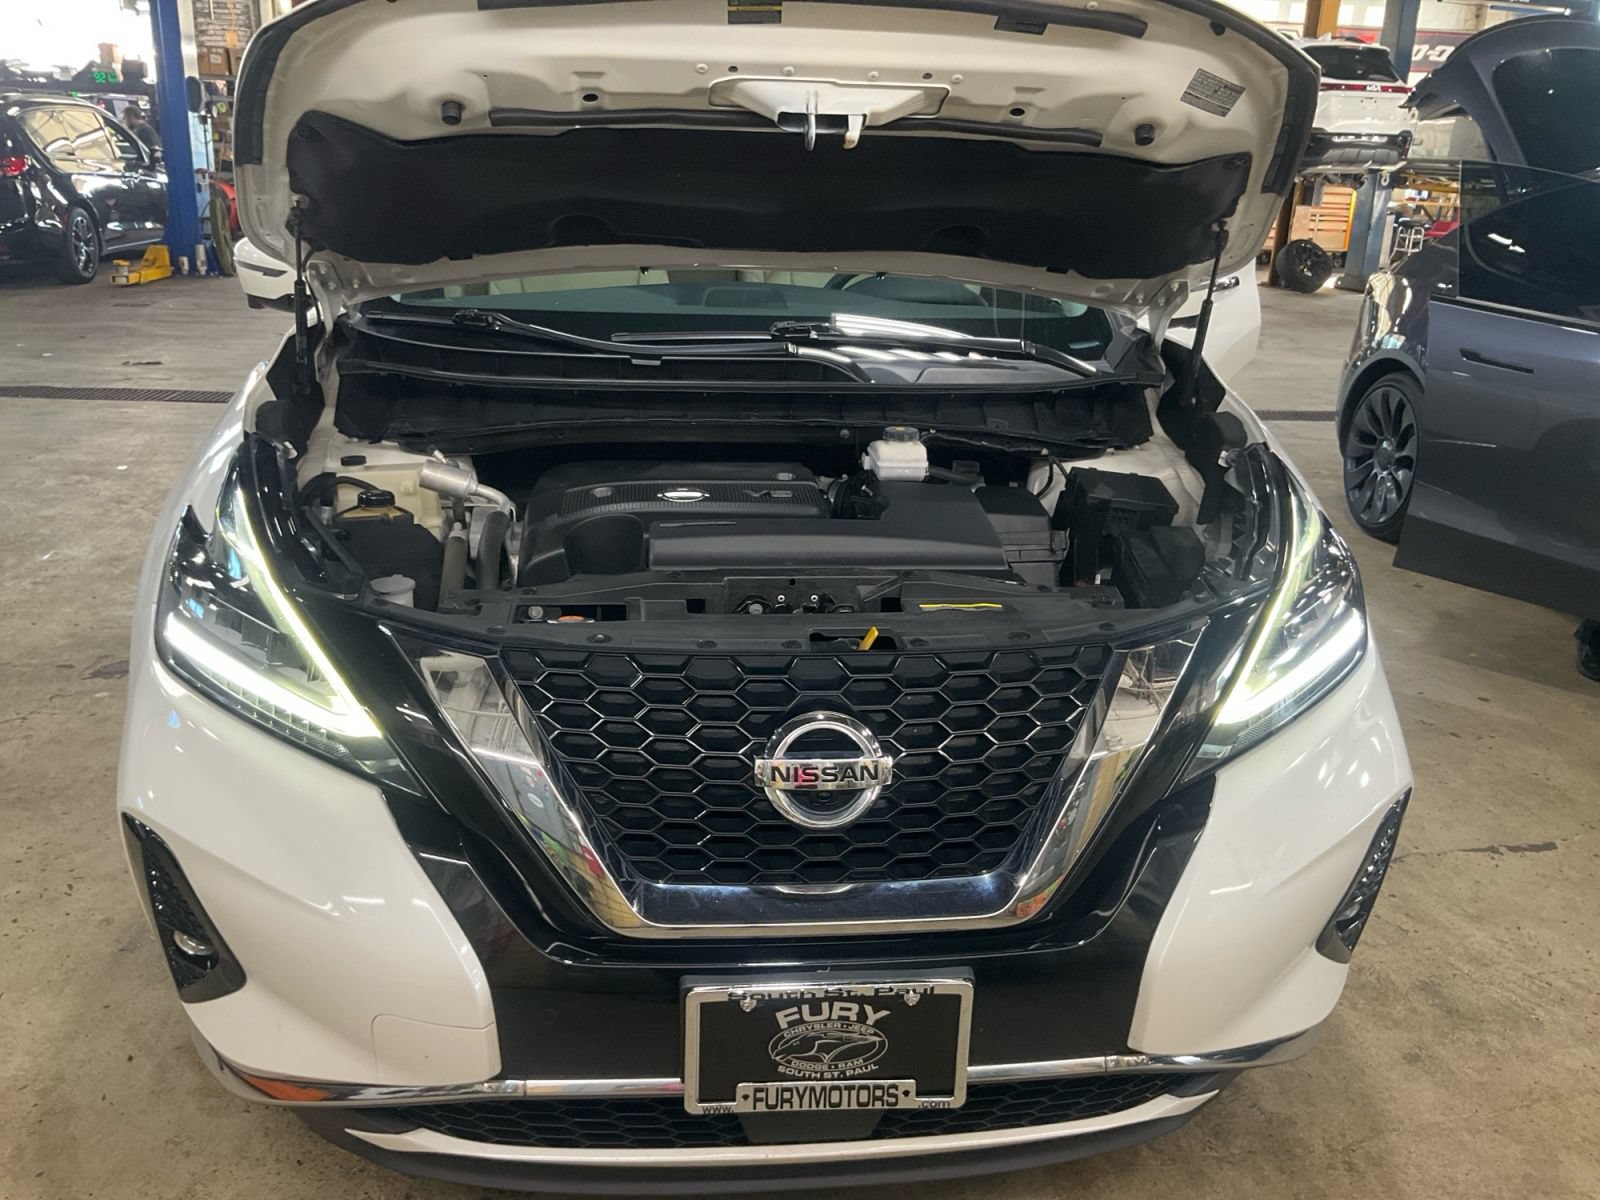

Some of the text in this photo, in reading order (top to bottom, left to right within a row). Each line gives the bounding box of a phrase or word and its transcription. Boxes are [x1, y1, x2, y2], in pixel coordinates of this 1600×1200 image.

[770, 763, 880, 784] NISSAN
[775, 1001, 892, 1030] FURY
[783, 1021, 875, 1039] CHRYSLER JEEP
[776, 1062, 880, 1080] SOUTH ST. PAUL
[790, 1058, 864, 1071] DODGE RAM
[701, 1083, 951, 1115] www. FURYMOTORS .com
